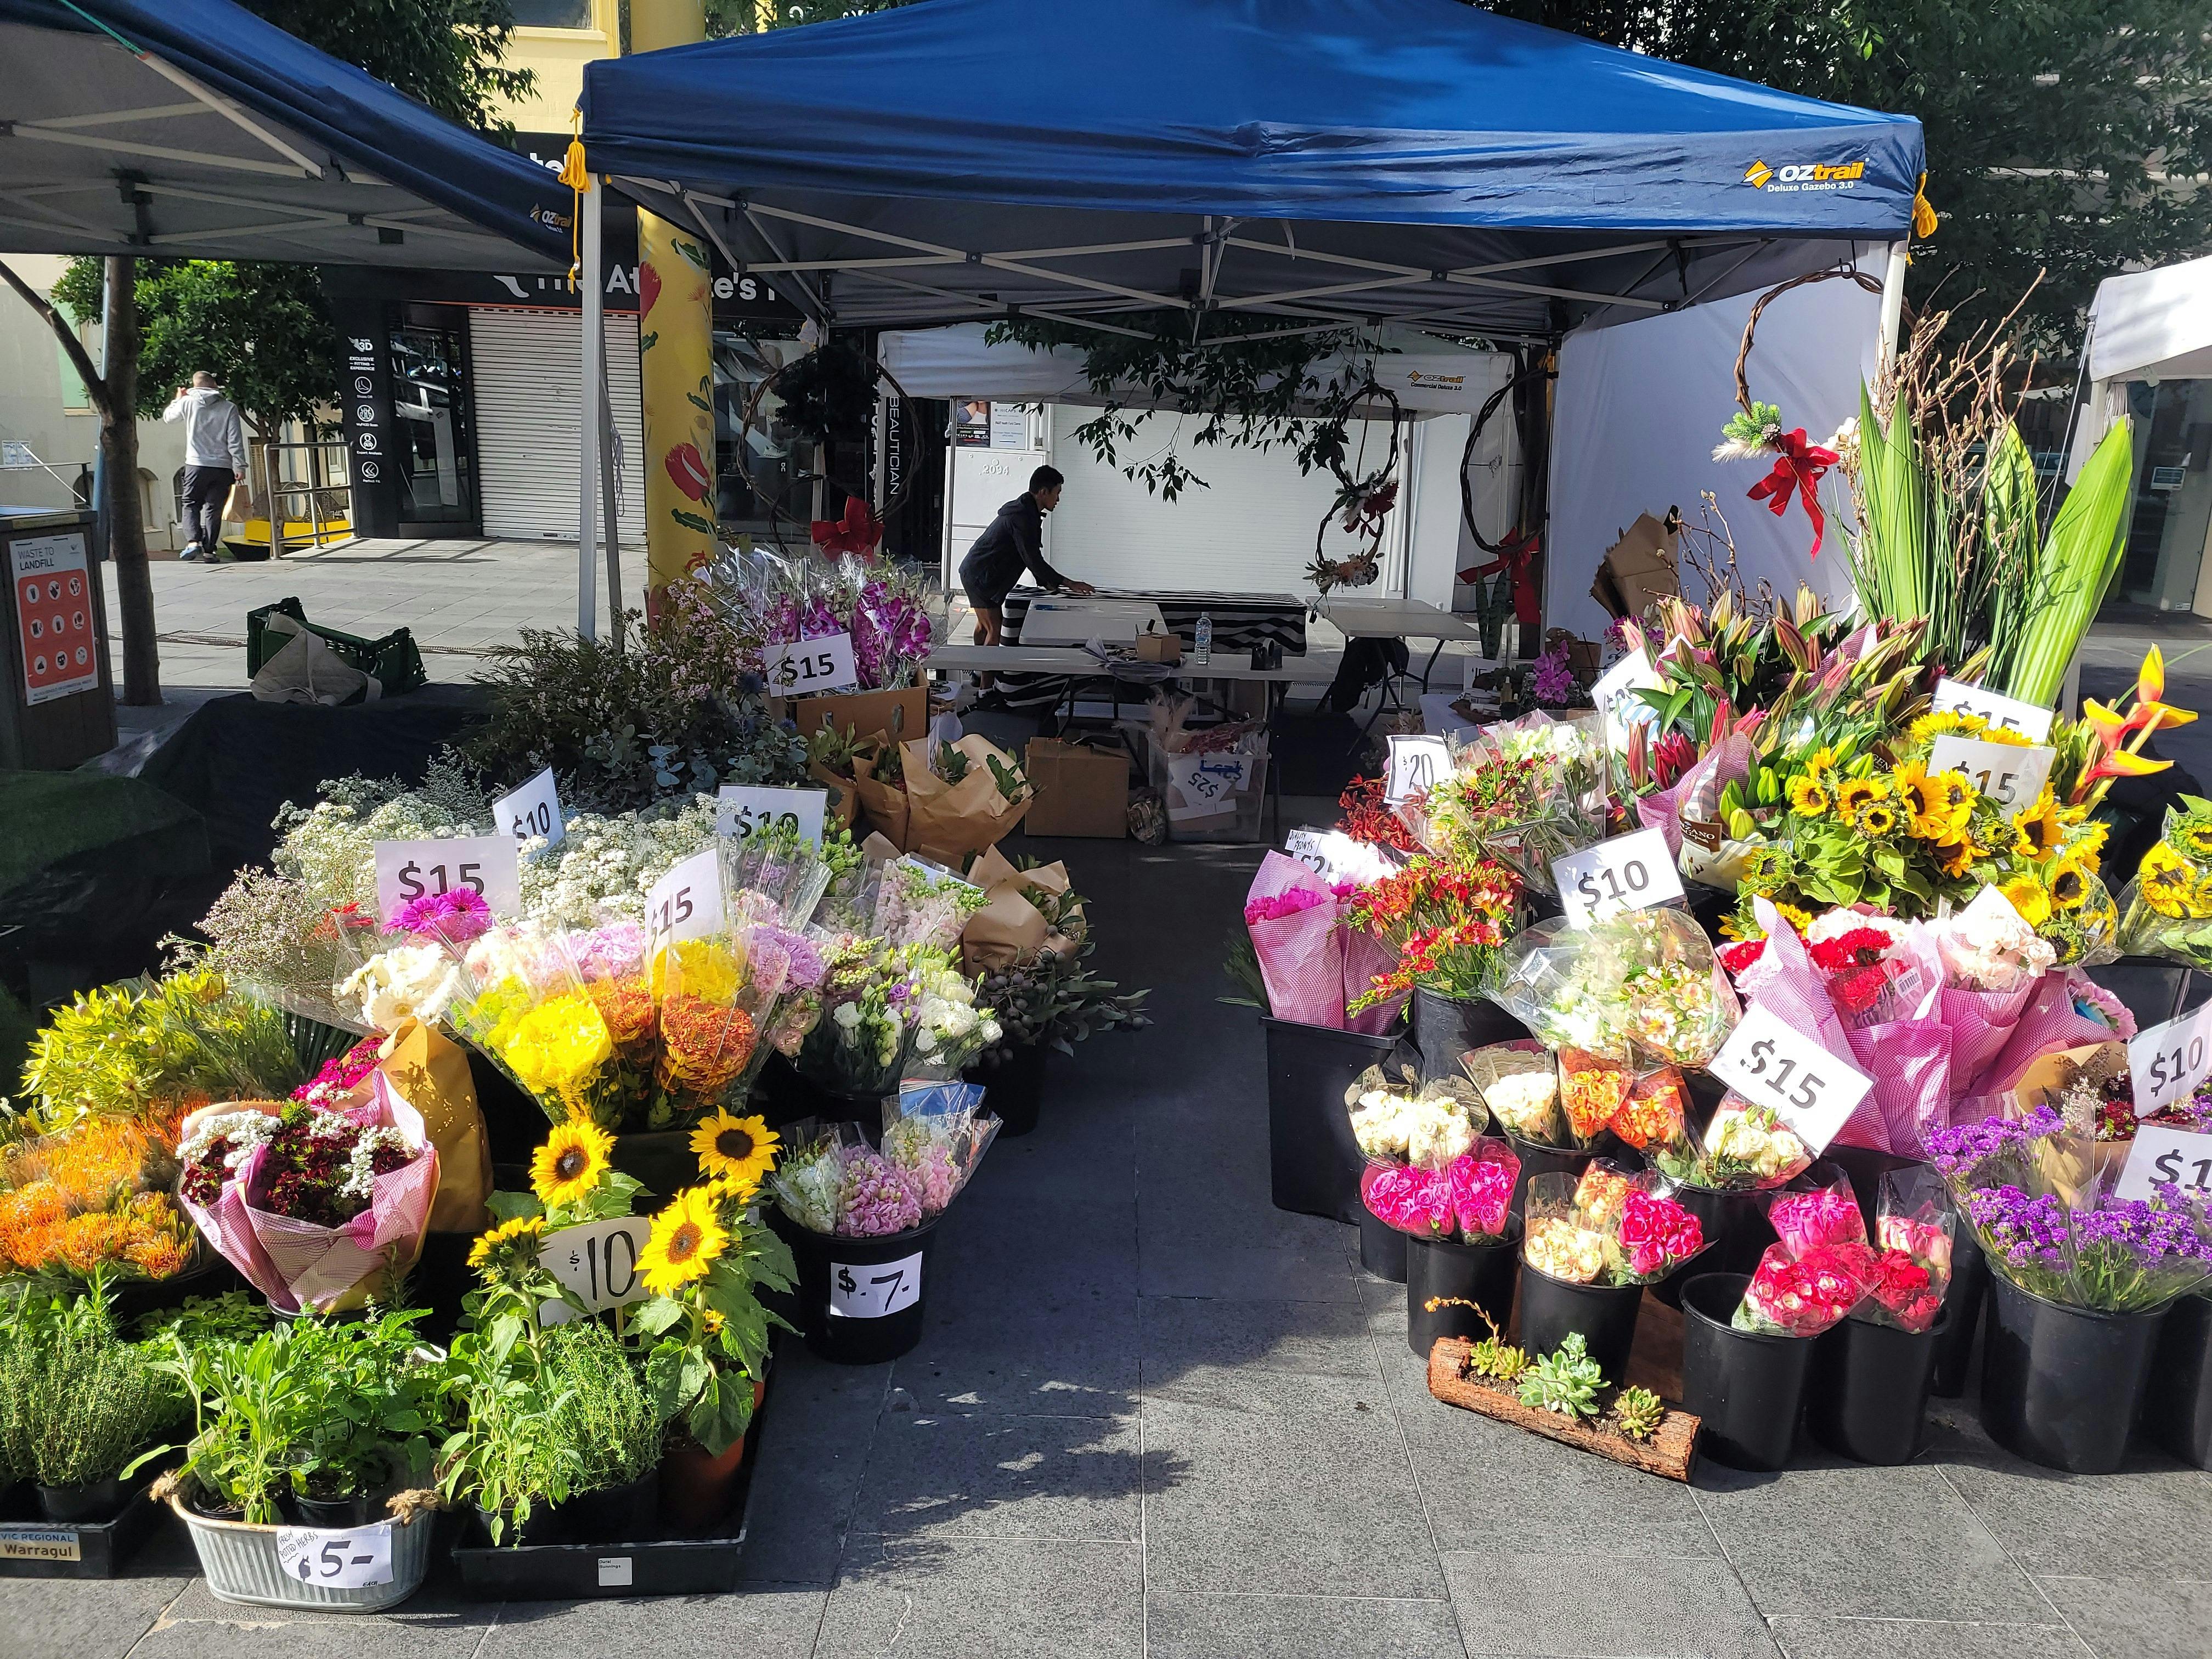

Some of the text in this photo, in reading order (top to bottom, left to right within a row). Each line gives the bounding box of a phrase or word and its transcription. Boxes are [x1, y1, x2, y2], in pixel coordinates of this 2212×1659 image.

[1779, 161, 1865, 182] OZtrail
[1768, 181, 1854, 193] Deluxe Gazebo 3.0
[359, 342, 373, 351] 3D
[889, 396, 900, 494] BEAUTICIAN
[983, 464, 1009, 476] 2094
[18, 546, 54, 560] WASTE TO
[20, 558, 54, 571] LANDFILL
[781, 652, 835, 684] $15
[1188, 772, 1219, 799] $25
[1949, 760, 2020, 805] 15
[1578, 860, 1649, 912] $10
[1740, 1039, 1826, 1109] $15
[2150, 1036, 2203, 1098] $10
[21, 1534, 74, 1542] REGIONAL
[278, 1530, 294, 1545] FRESH
[279, 1531, 318, 1559] POTTED HERBS
[4, 1544, 72, 1559] Warragul
